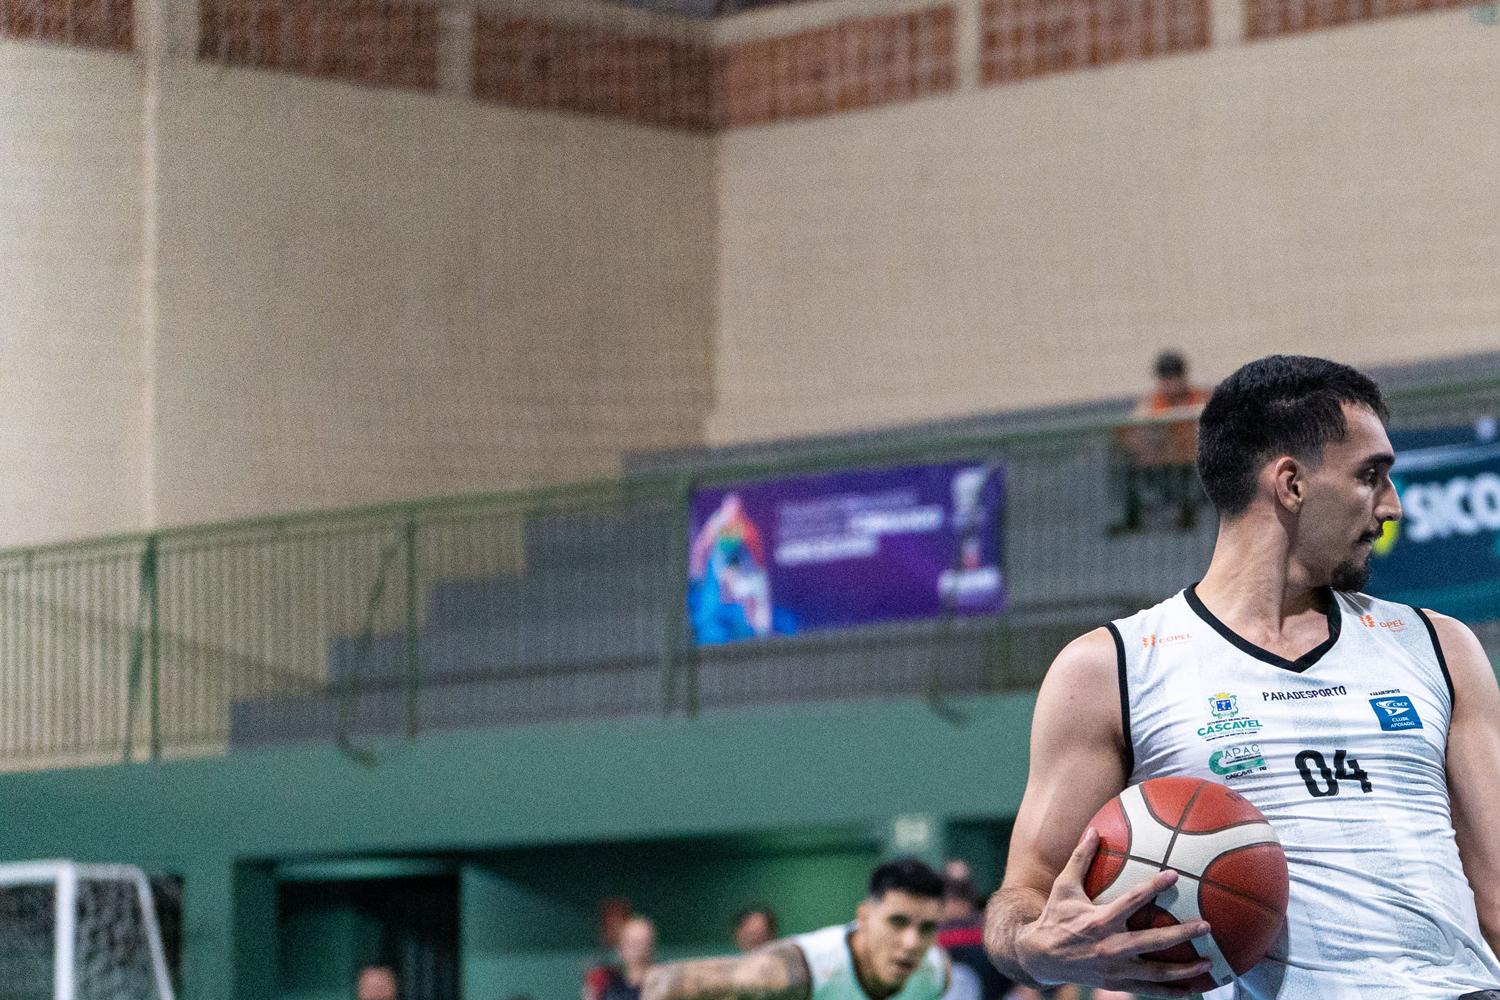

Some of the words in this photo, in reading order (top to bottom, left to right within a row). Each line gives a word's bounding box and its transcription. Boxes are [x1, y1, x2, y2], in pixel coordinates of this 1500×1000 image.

[1262, 685, 1347, 702] PARADESPORTO
[1197, 719, 1263, 736] CASCAVEL
[1294, 749, 1374, 798] 04
